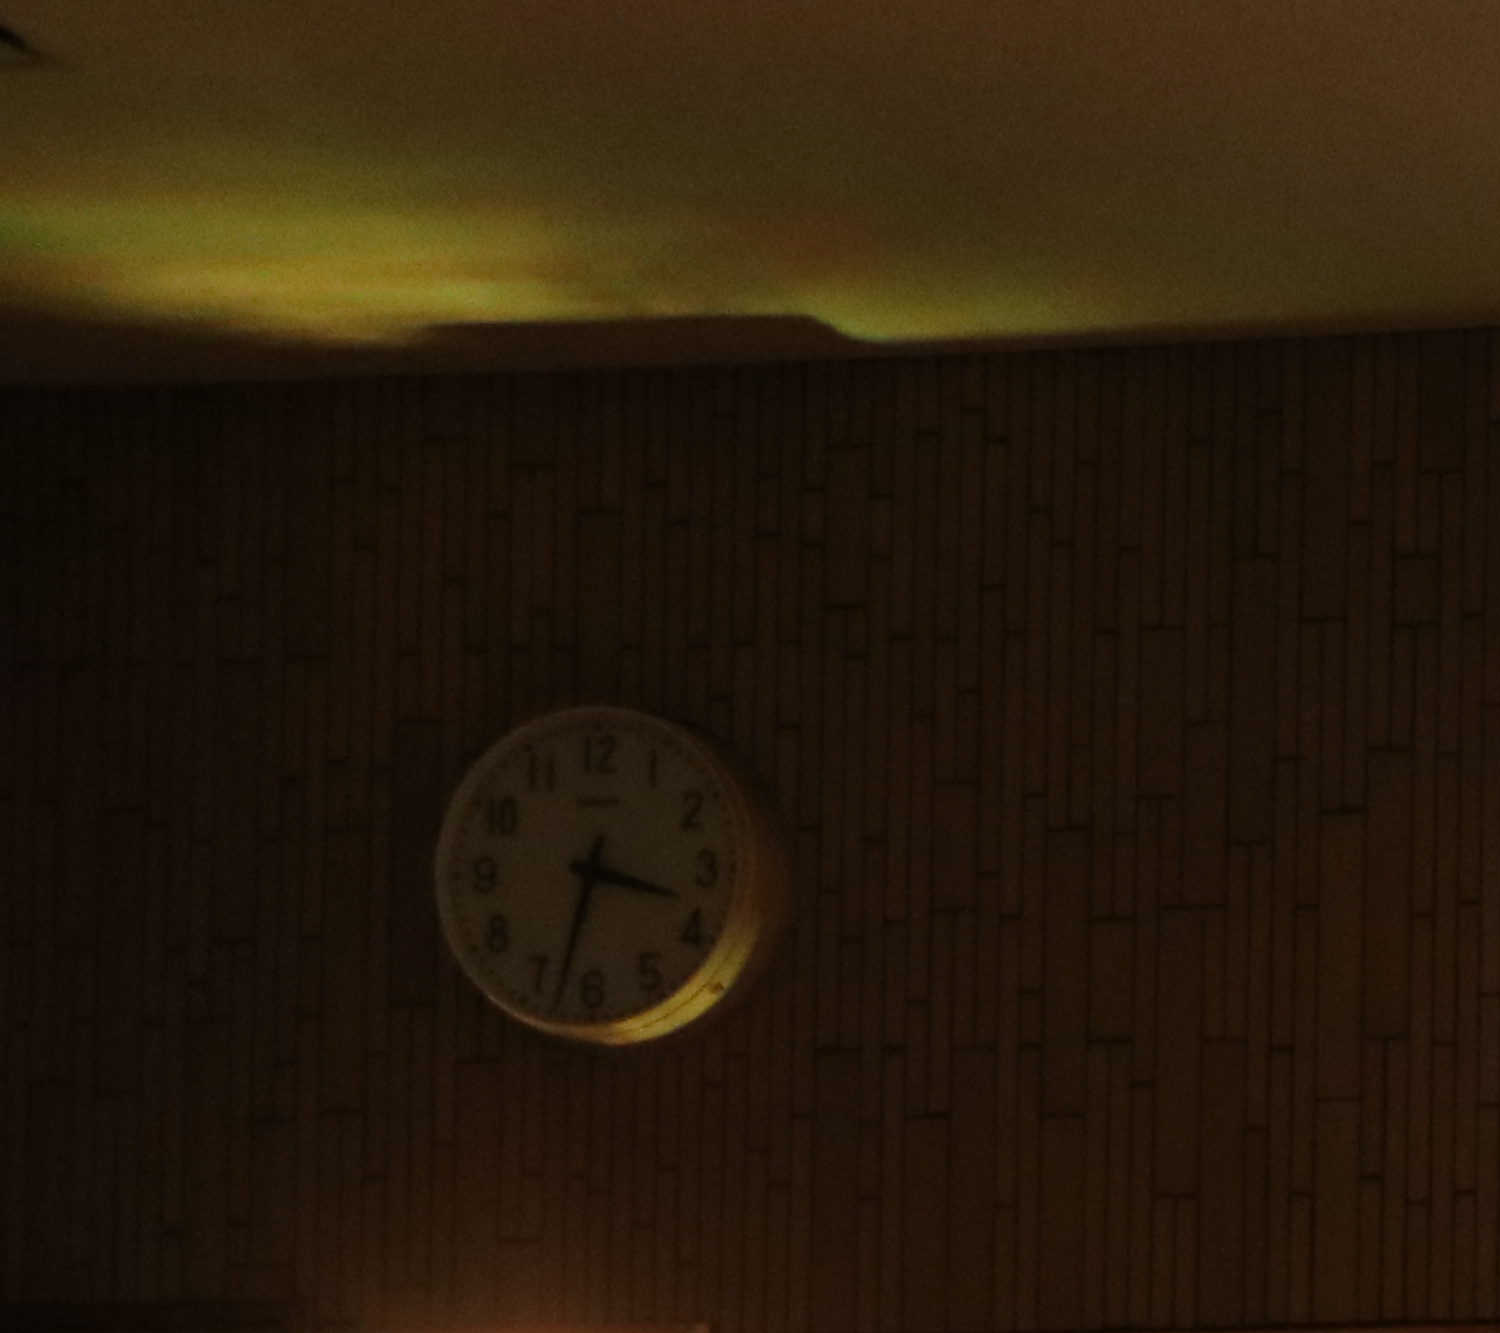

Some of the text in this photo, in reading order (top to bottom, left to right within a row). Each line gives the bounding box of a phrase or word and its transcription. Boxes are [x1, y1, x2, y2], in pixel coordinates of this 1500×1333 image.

[527, 752, 554, 792] 11
[584, 734, 618, 774] 12
[649, 750, 658, 790] 1
[486, 798, 518, 837] 10
[682, 790, 703, 832] 2
[472, 855, 497, 894] 9
[697, 849, 717, 888] 3
[487, 914, 508, 954] 8
[681, 907, 703, 947] 4
[528, 954, 549, 994] 7
[581, 970, 604, 1009] 6
[639, 951, 660, 991] 5
